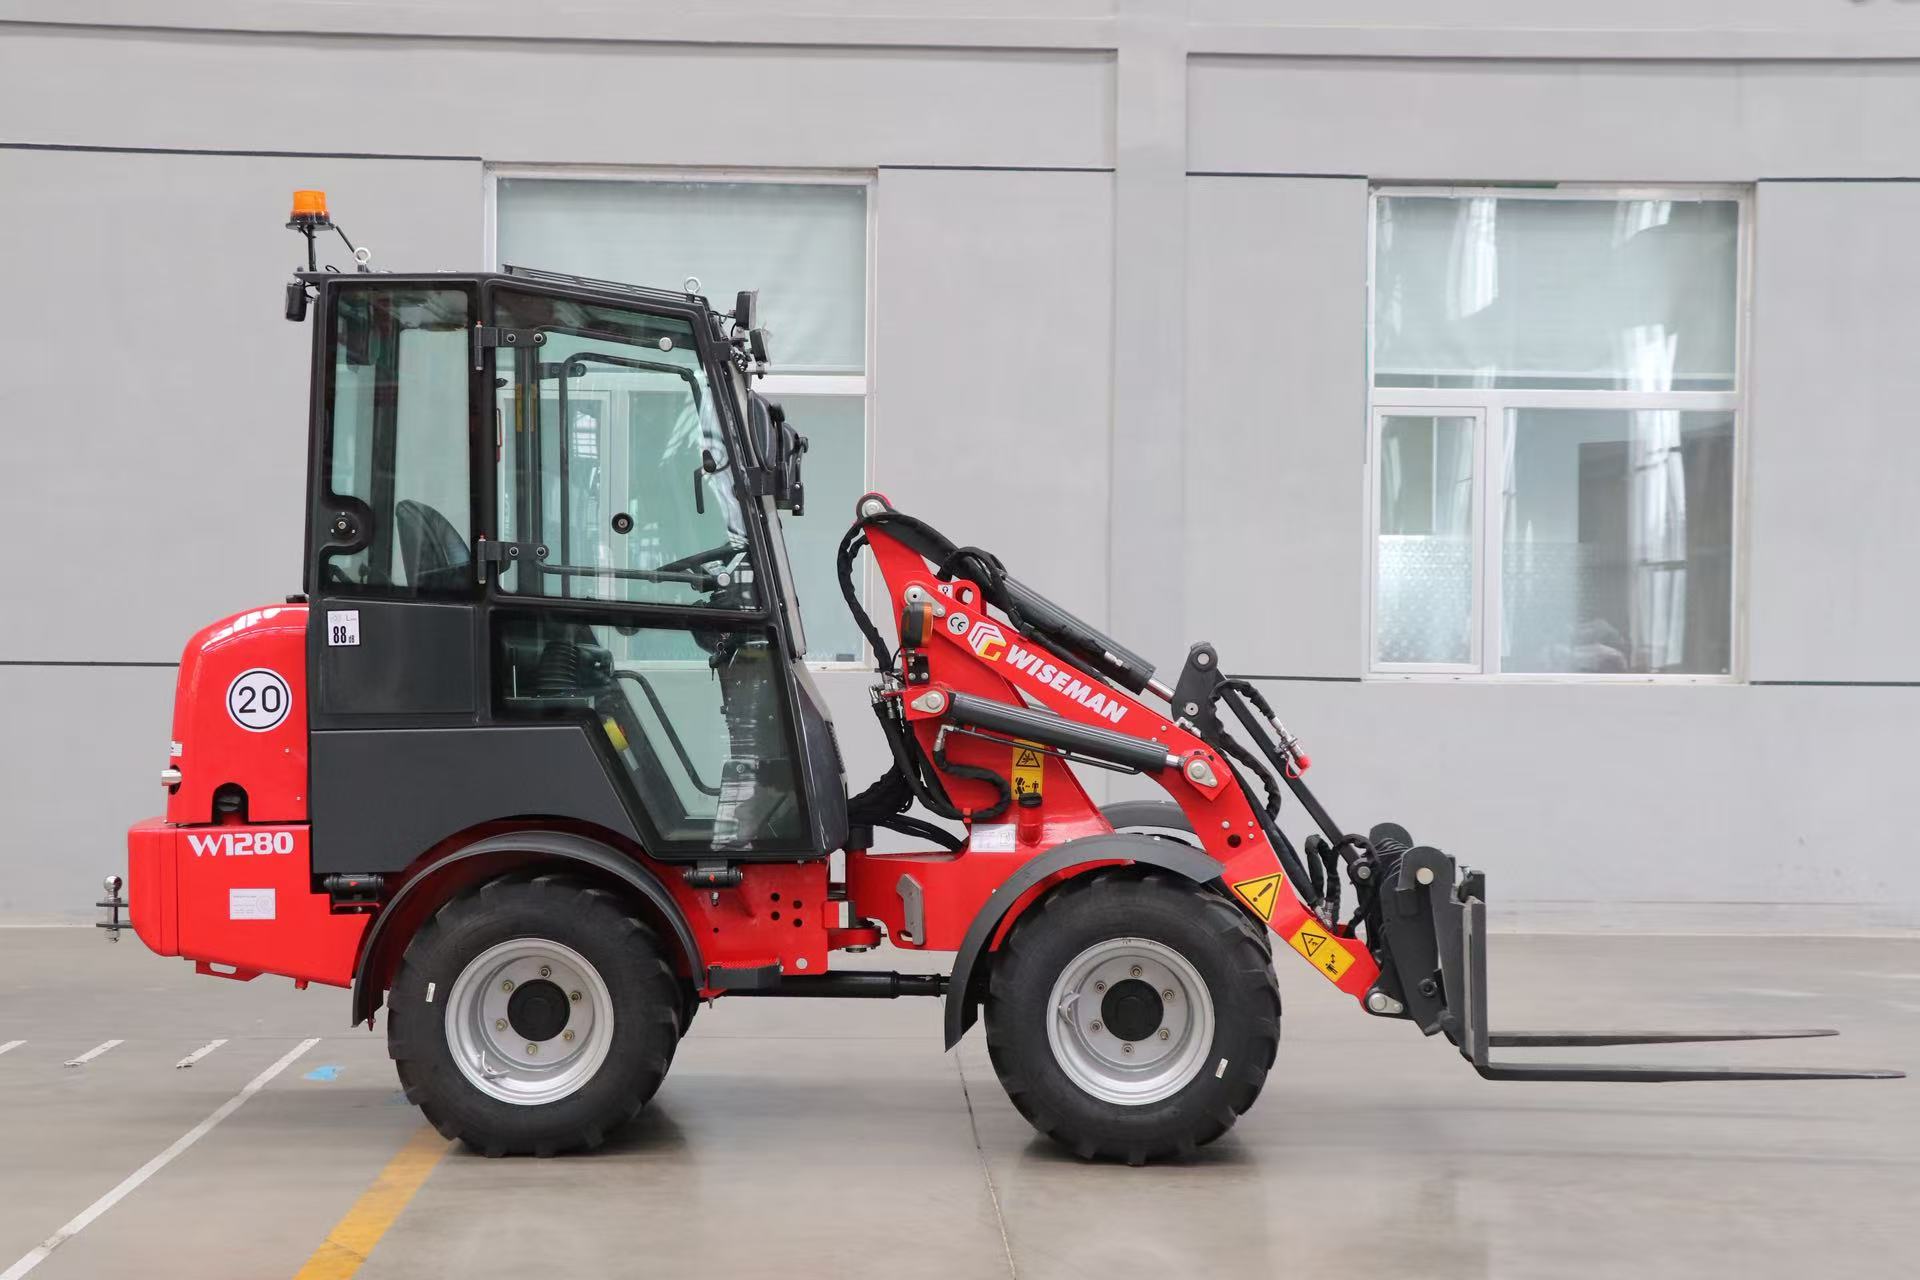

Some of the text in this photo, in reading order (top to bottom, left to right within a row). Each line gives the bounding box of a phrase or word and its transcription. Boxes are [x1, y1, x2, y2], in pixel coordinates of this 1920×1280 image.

[333, 625, 347, 644] 88
[950, 616, 966, 632] CE
[1005, 644, 1128, 724] WISEMAN
[238, 685, 281, 713] 20
[187, 832, 294, 857] W1280
